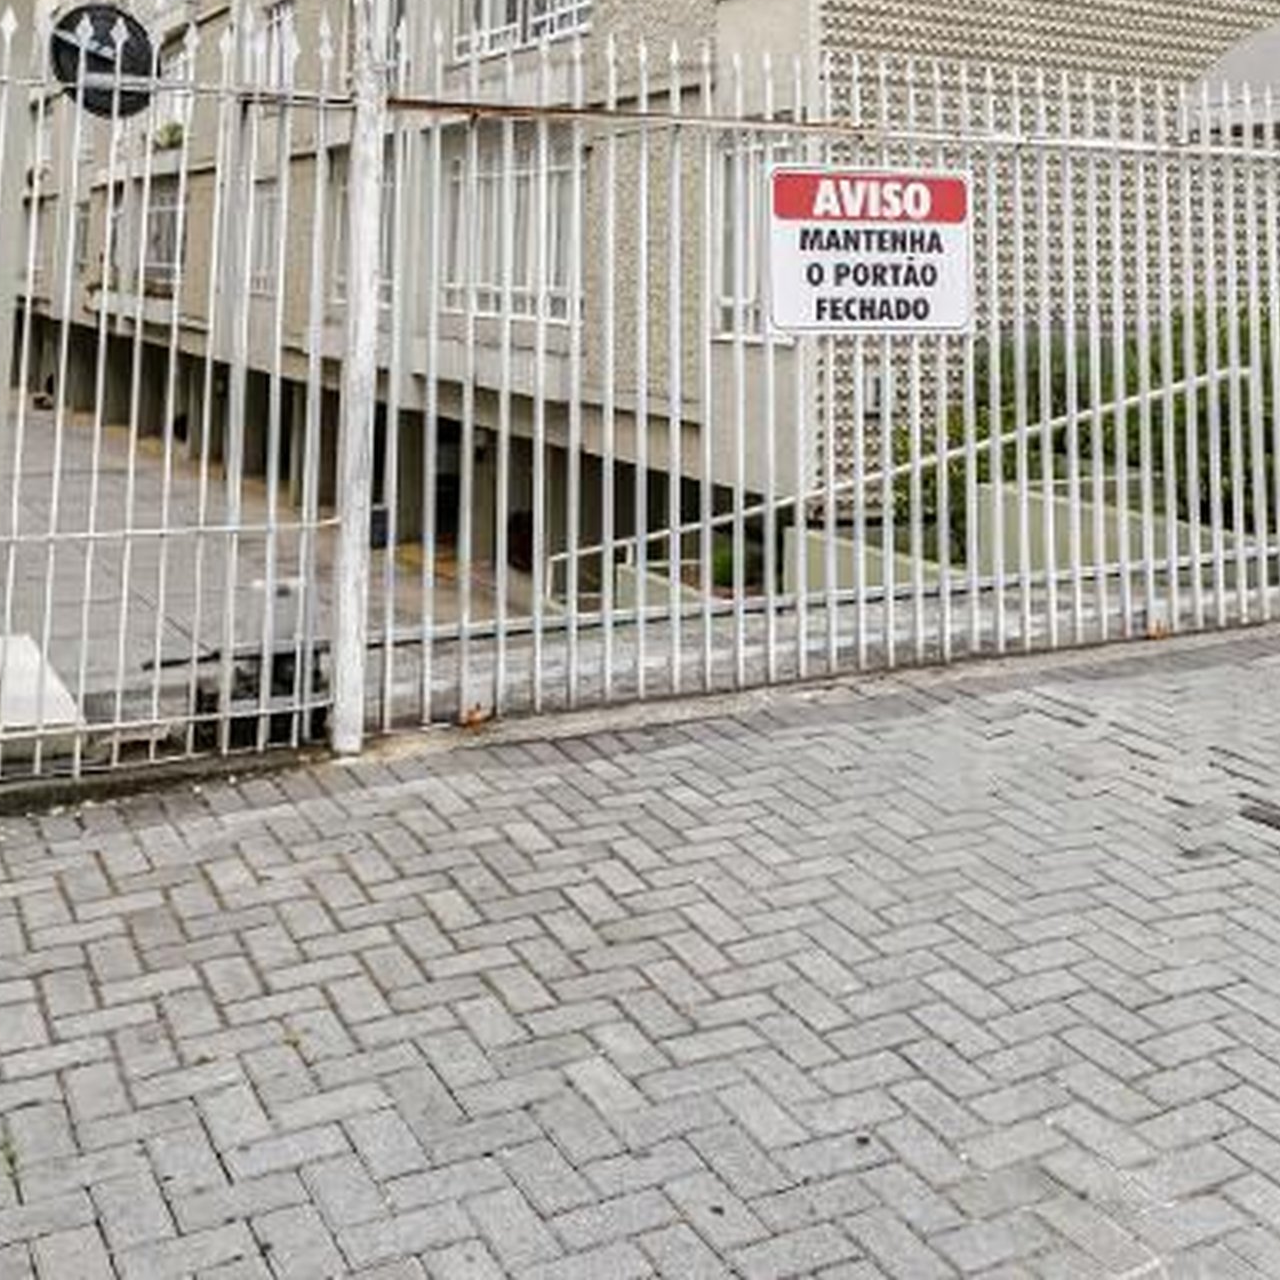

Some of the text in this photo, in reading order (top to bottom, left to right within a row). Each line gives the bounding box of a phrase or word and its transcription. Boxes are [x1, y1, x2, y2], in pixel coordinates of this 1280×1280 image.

[812, 178, 932, 218] AVISO
[799, 228, 944, 253] MANTENHA
[805, 256, 938, 287] O PORTÃO
[816, 297, 930, 321] FECHADO
